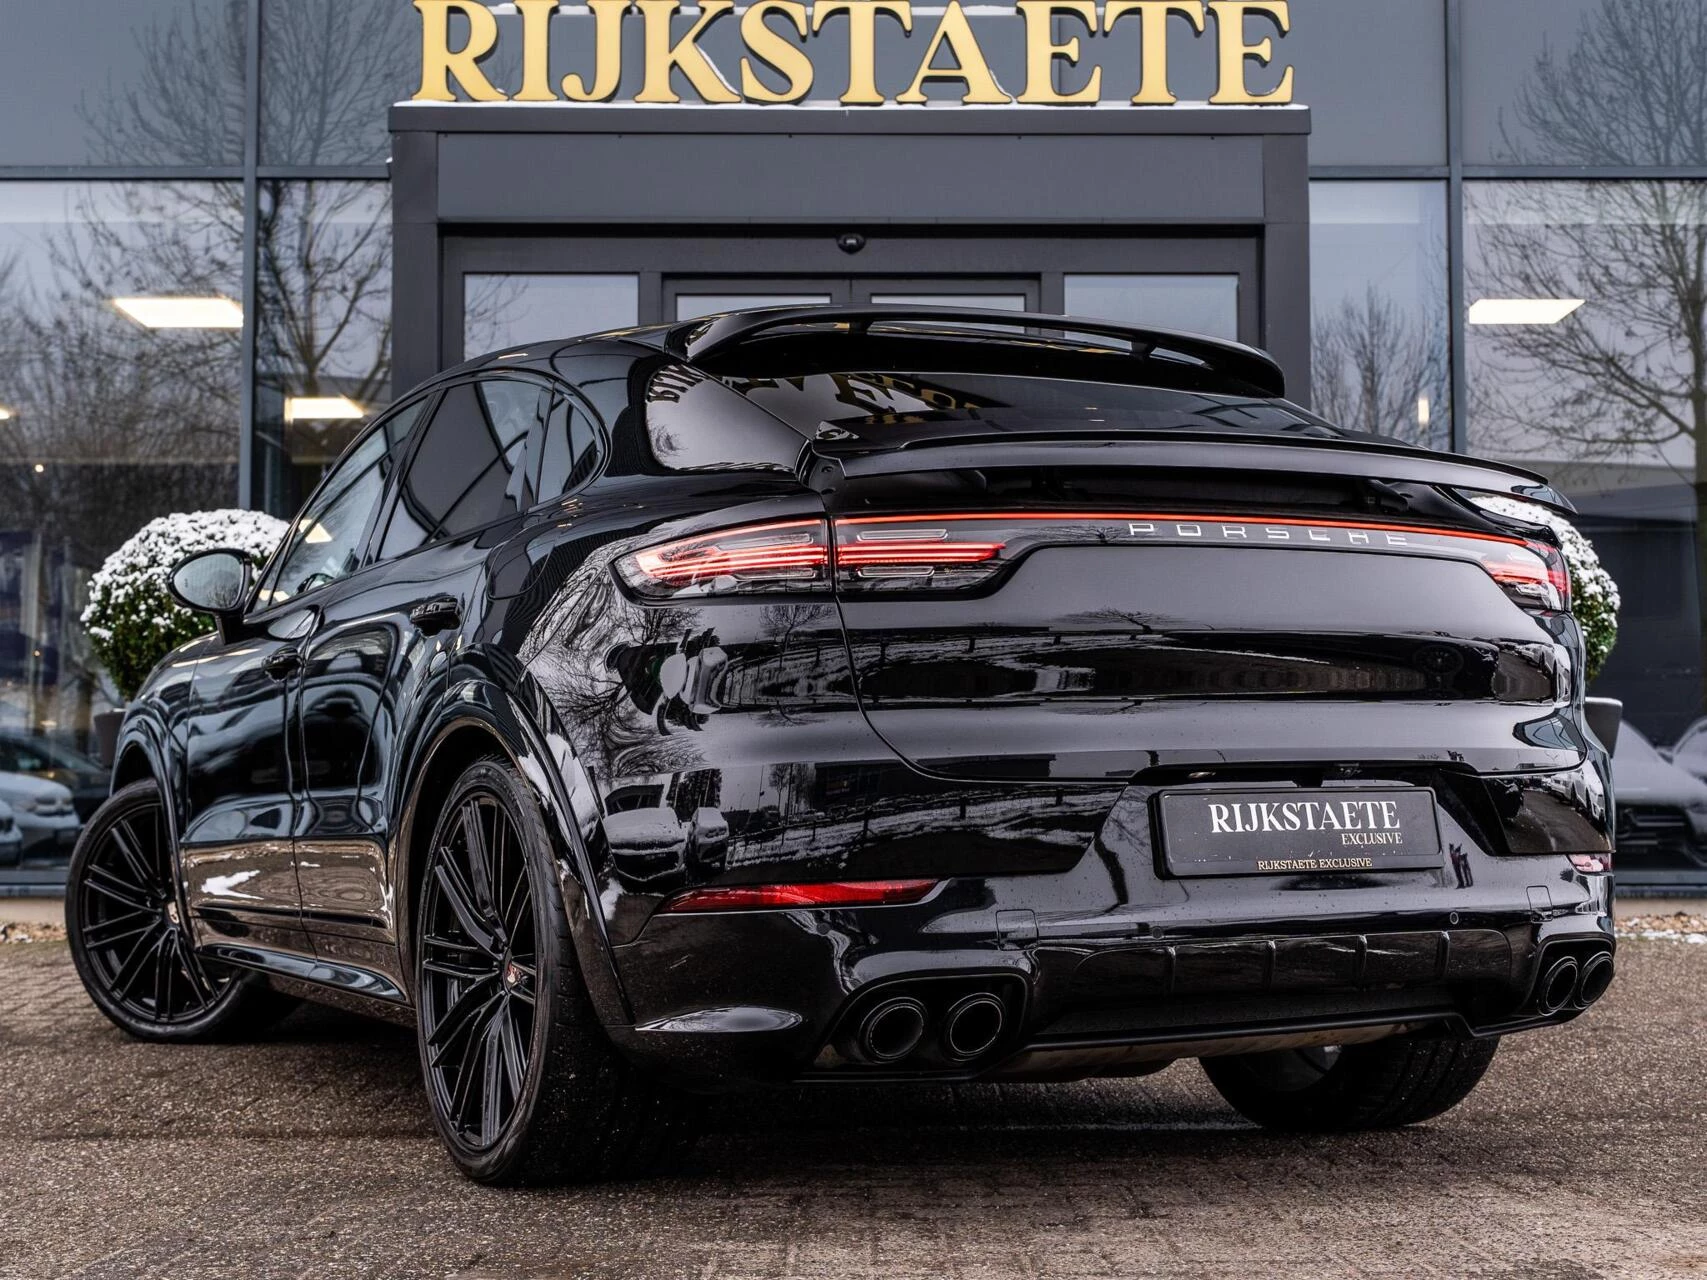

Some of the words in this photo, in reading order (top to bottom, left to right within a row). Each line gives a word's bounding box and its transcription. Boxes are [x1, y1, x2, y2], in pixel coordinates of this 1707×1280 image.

[411, 0, 1295, 105] RIJKSTAETE
[1128, 522, 1409, 546] PORSCHE
[1208, 800, 1400, 833] RIJKSTAETE
[1341, 832, 1403, 846] EXCLUSIVE
[1257, 859, 1318, 871] RIJKSTAETE
[1319, 858, 1373, 869] EXCLUSIVE
